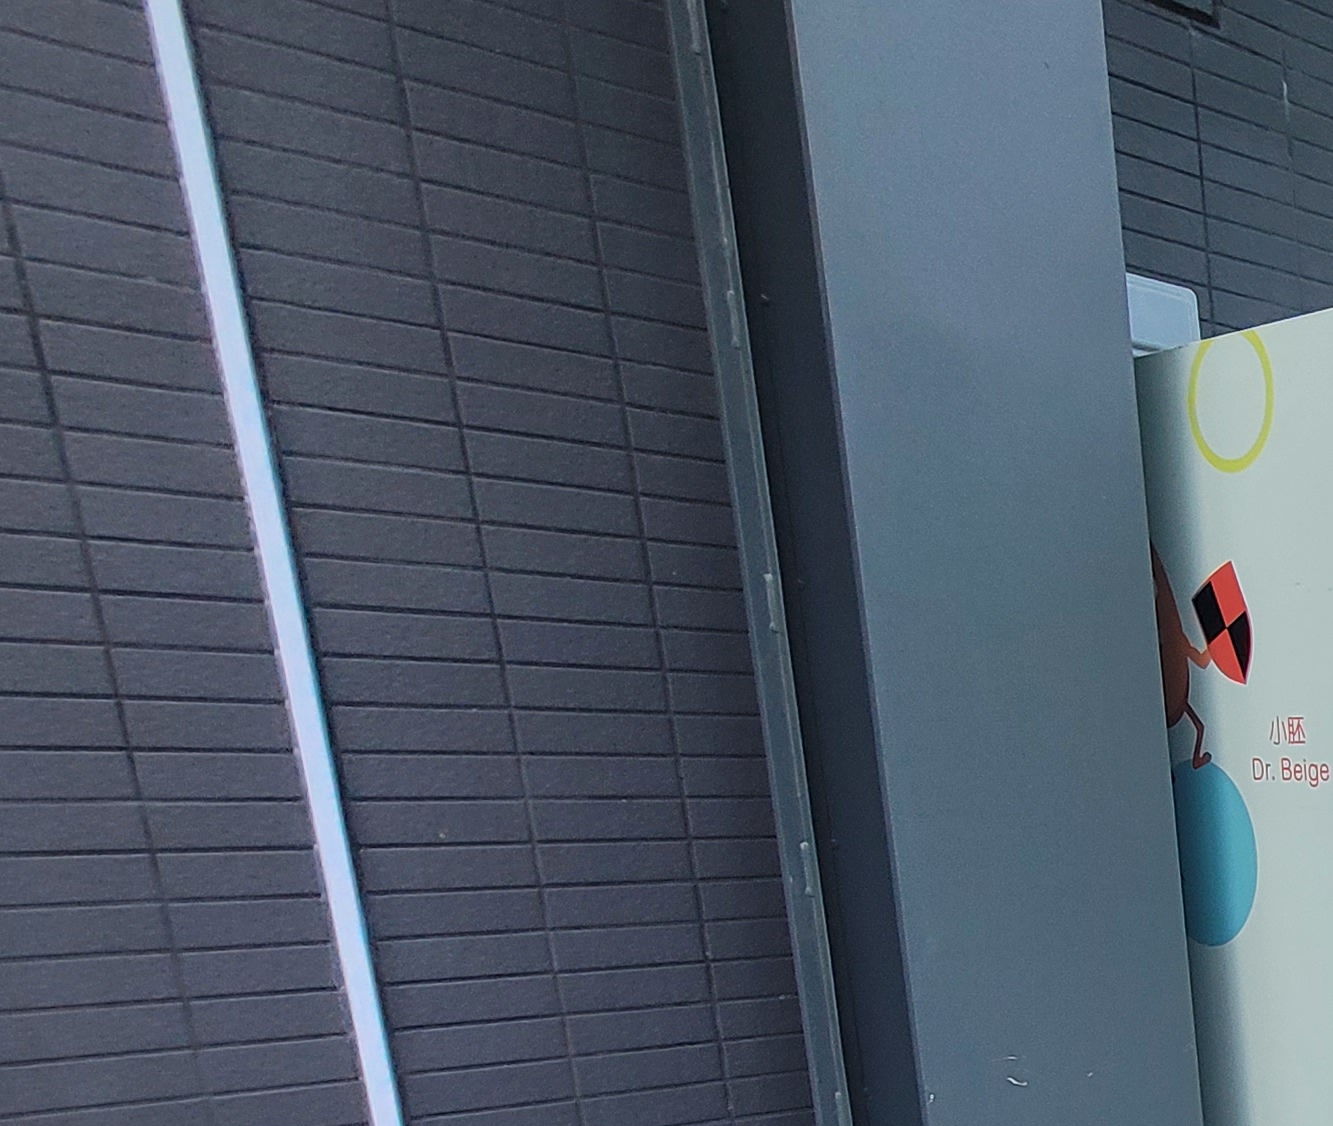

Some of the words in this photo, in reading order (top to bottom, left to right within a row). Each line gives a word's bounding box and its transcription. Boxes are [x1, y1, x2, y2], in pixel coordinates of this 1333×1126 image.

[1269, 715, 1306, 746] 小胚
[1252, 757, 1276, 781] Dr.
[1281, 757, 1330, 788] Beige
